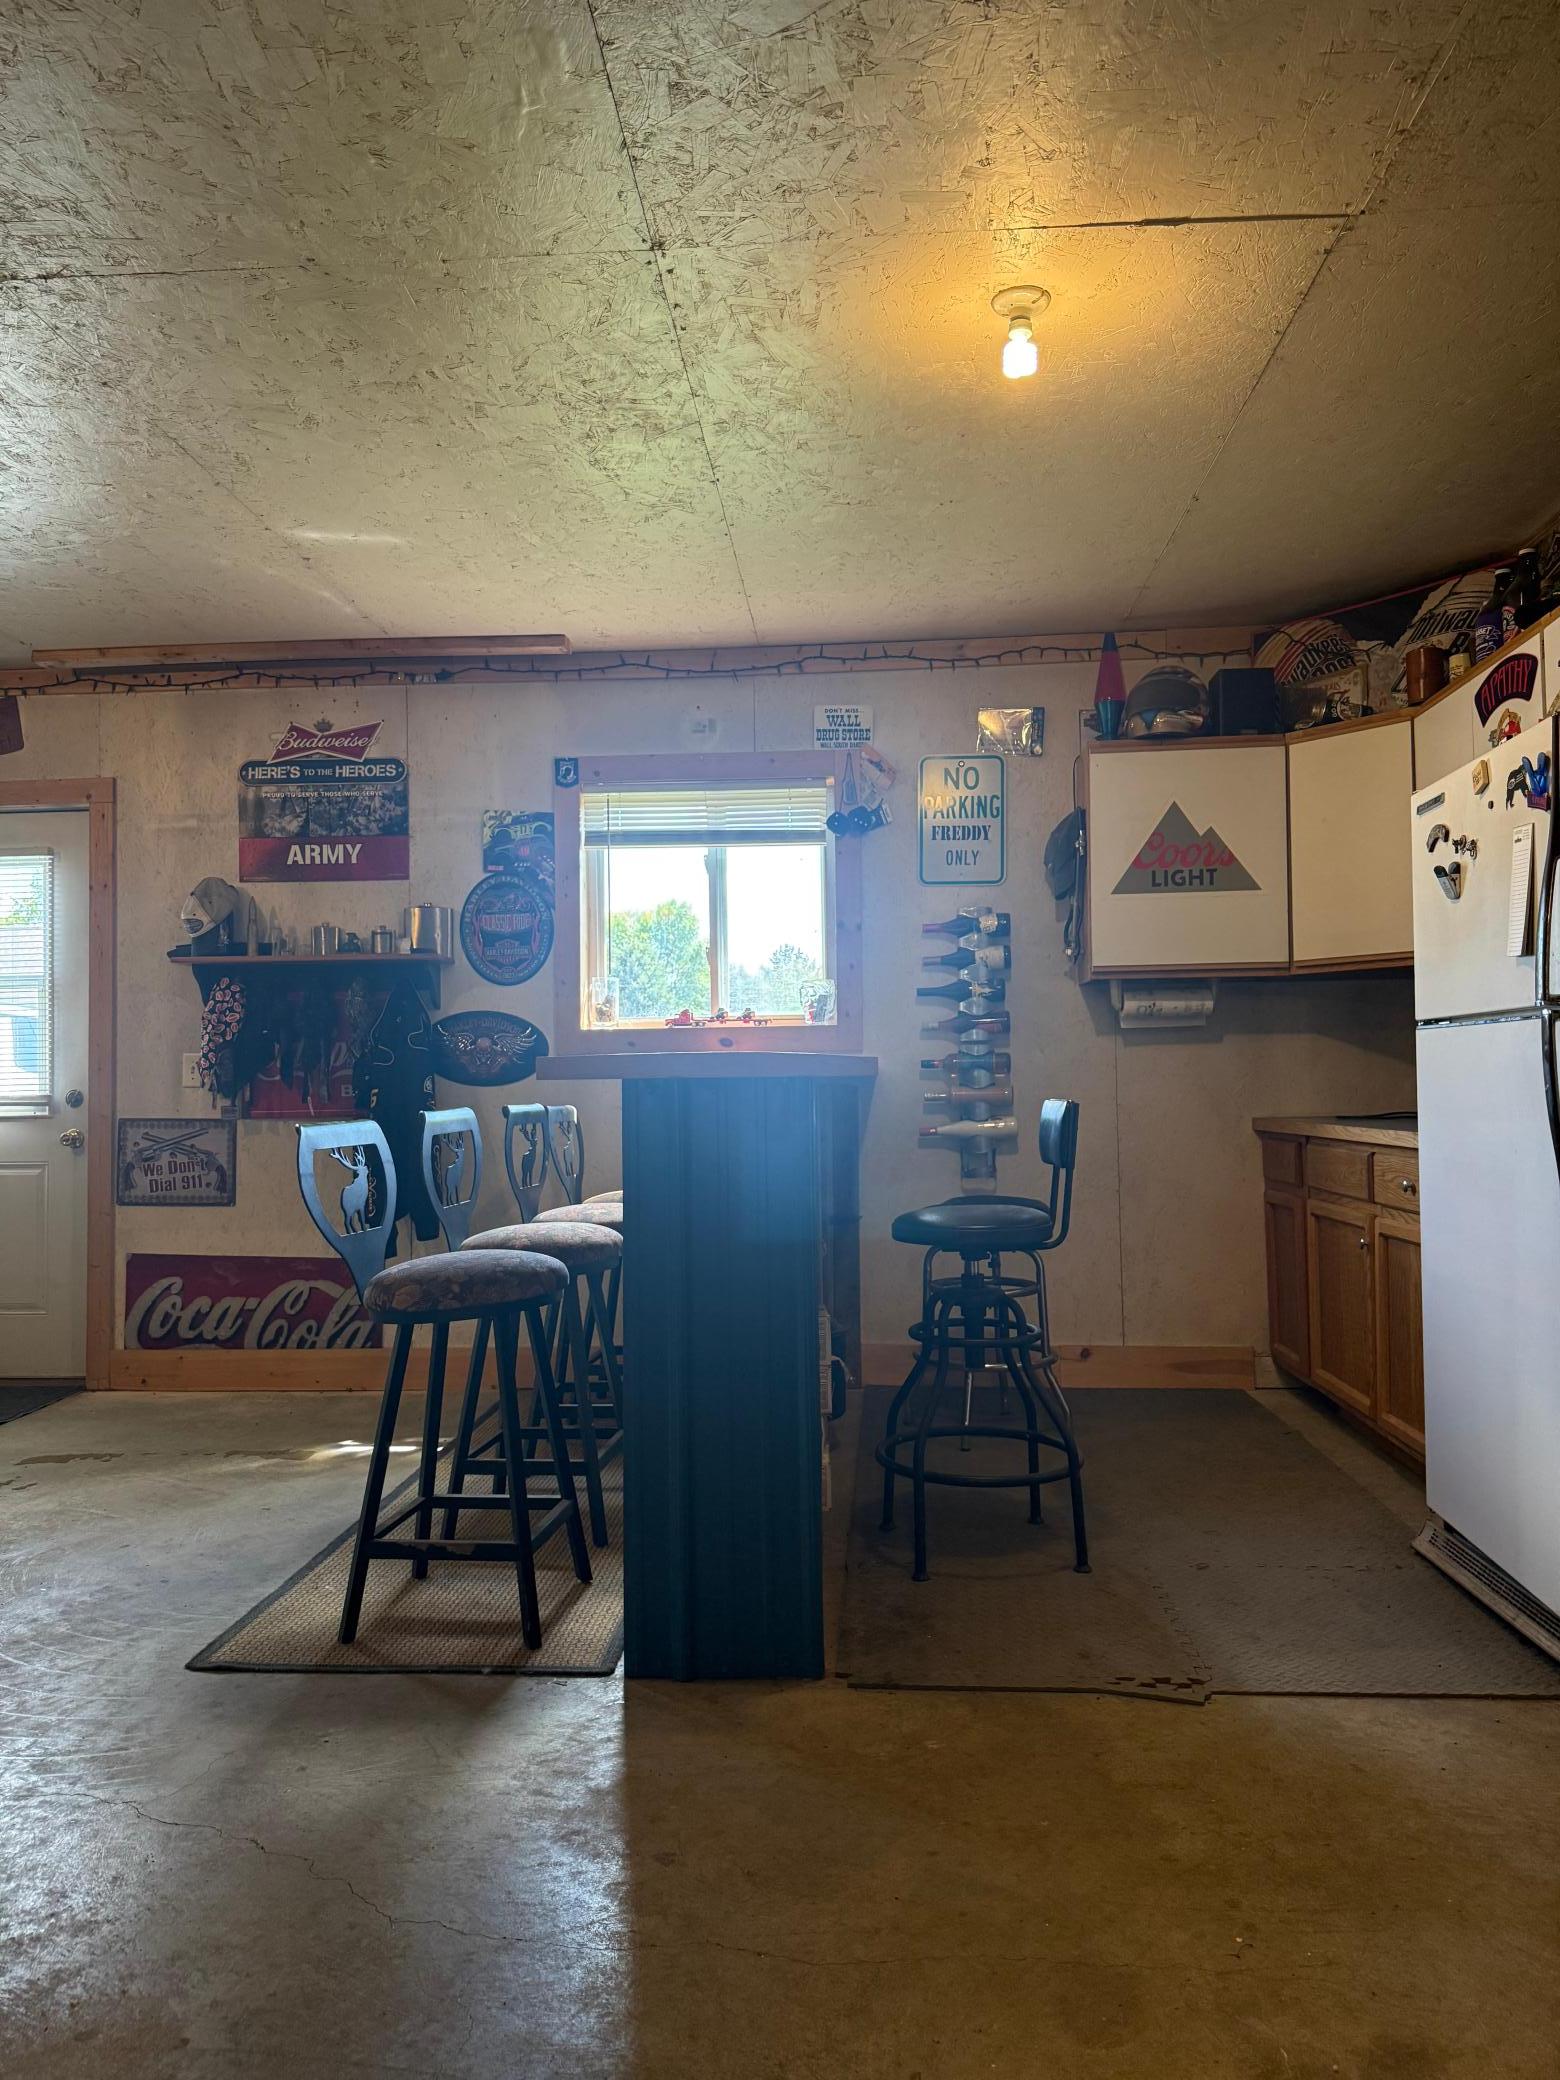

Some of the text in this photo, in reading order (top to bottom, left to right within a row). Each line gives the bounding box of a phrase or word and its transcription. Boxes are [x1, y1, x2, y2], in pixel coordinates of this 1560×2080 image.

[1481, 658, 1532, 715] APATHY
[826, 715, 861, 727] WALL
[816, 728, 871, 741] DRUG STORE
[247, 764, 396, 779] HERE'S TO THE HEROES
[943, 766, 980, 791] NO
[924, 794, 1001, 819] PARKING
[931, 824, 991, 841] FREDDY
[287, 844, 362, 865] ARMY
[946, 850, 980, 866] ONLY
[1133, 831, 1237, 870] Coors
[1151, 868, 1218, 888] LIGHT
[142, 1158, 208, 1177] We Don't
[149, 1174, 203, 1193] Dial 911
[124, 1276, 376, 1349] Coca-Cola
